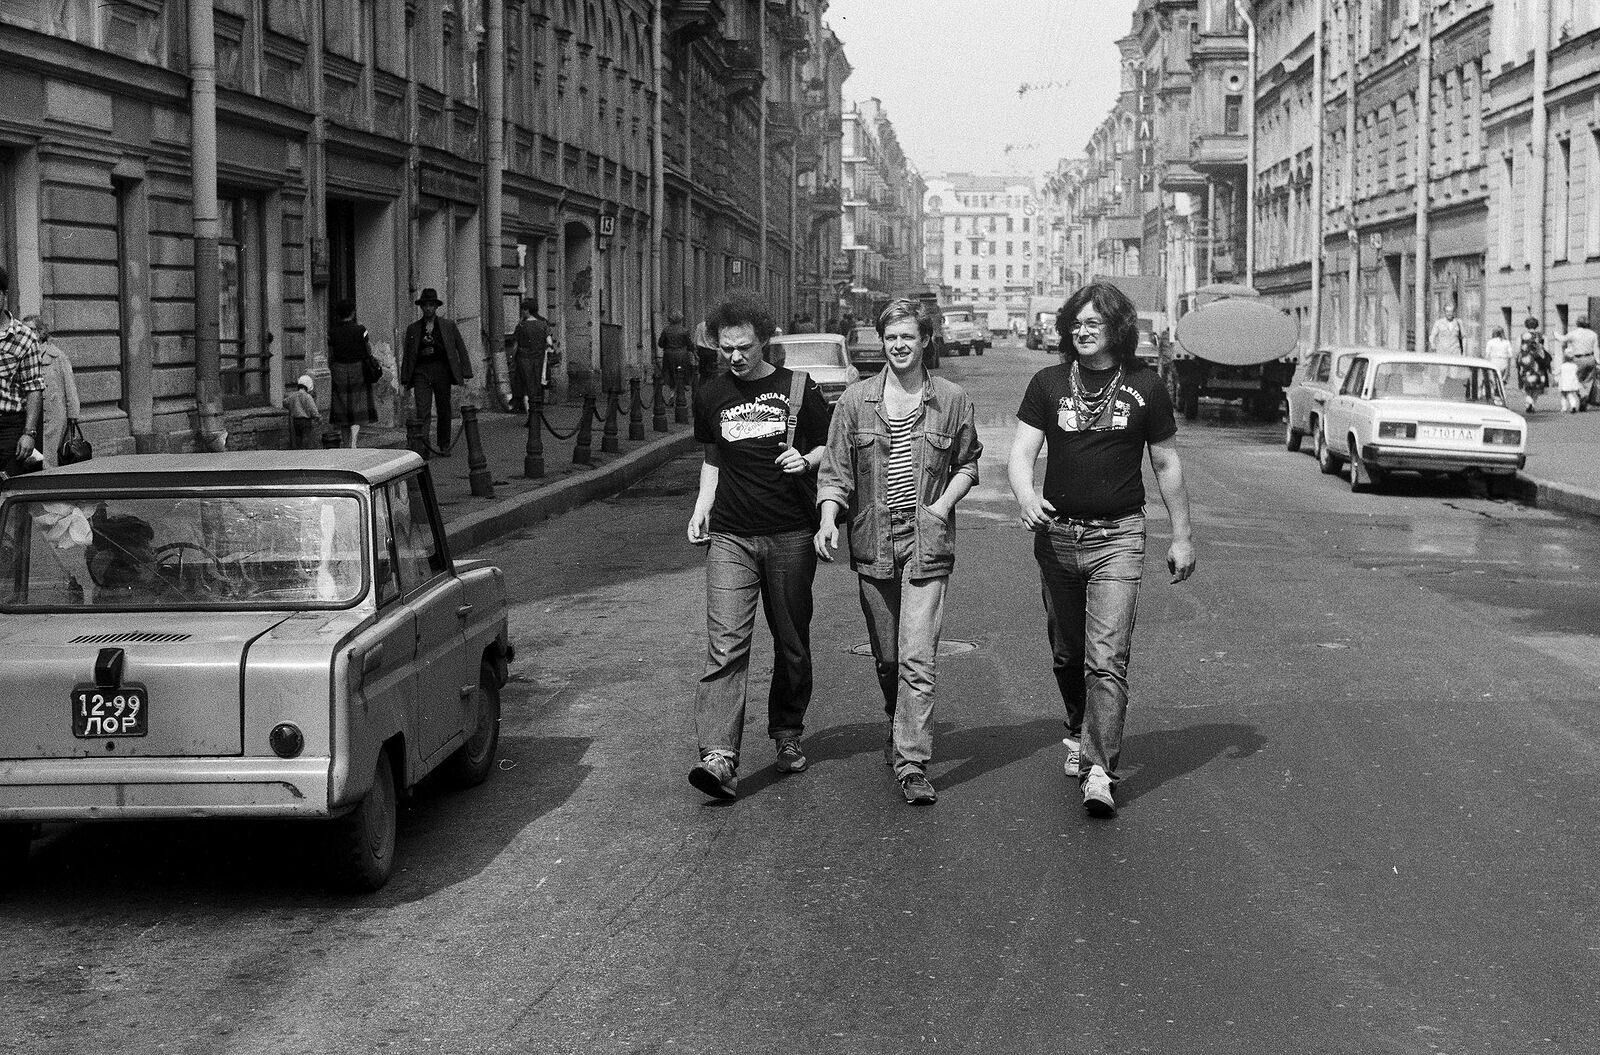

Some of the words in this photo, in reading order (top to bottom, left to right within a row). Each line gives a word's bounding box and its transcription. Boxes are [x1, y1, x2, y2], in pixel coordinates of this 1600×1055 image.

[603, 217, 612, 232] 13
[755, 392, 790, 407] AQUARI
[79, 694, 140, 717] 12-99
[84, 717, 136, 735] ЛОР
